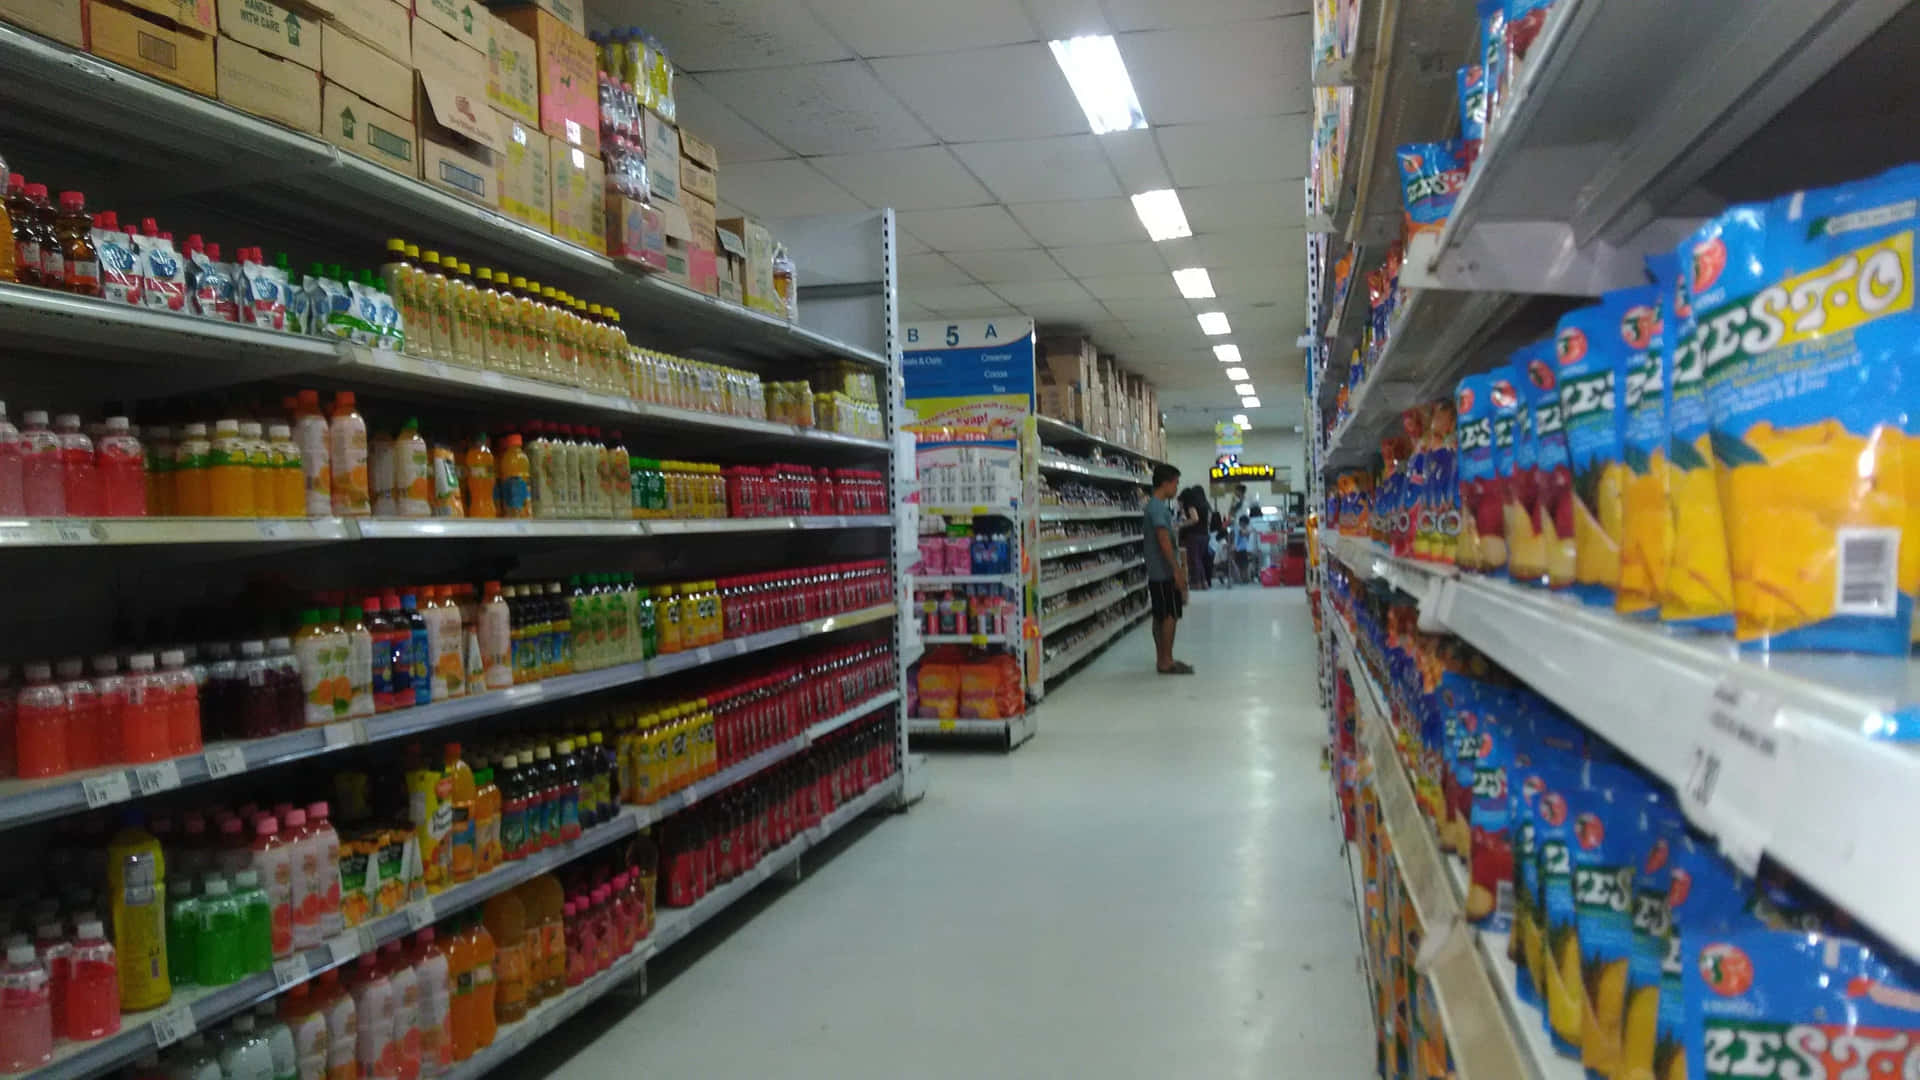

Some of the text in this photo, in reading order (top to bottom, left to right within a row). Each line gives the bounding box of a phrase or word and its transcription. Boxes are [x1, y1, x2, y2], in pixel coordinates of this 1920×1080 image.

[907, 323, 998, 347] B 5 A
